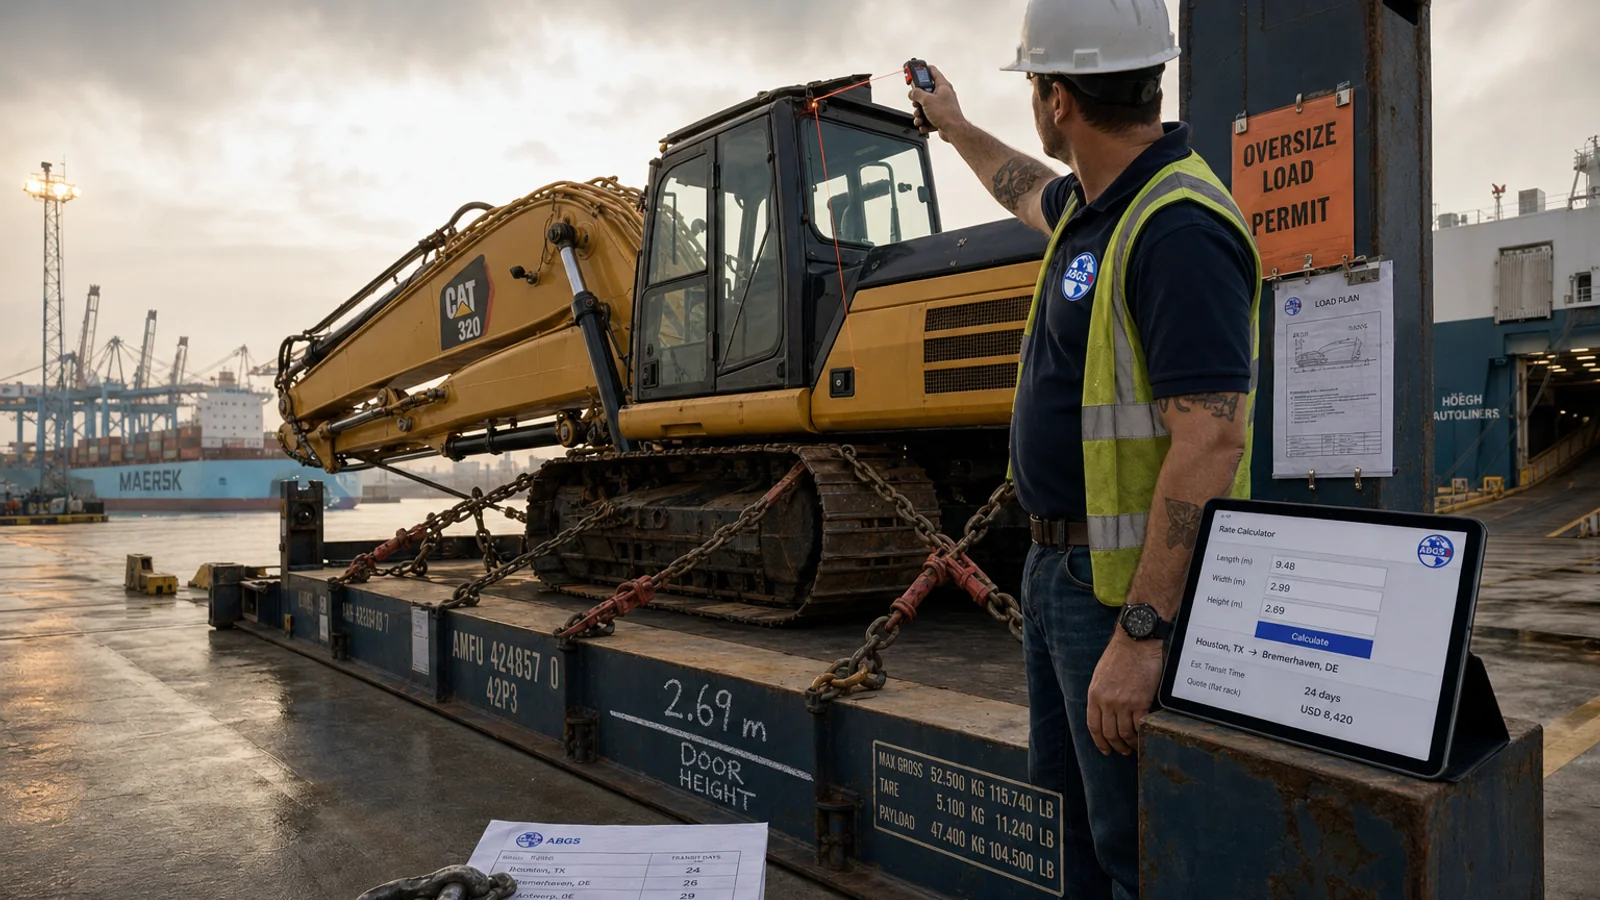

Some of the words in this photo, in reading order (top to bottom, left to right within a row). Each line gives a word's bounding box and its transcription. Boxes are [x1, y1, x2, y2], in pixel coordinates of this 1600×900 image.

[1243, 121, 1337, 168] OVERSIZE
[1263, 159, 1314, 193] LOAD
[1252, 196, 1330, 236] PERMIT
[445, 279, 476, 320] CAT
[1314, 298, 1337, 308] LOAD
[1338, 293, 1360, 304] PLAN
[458, 316, 481, 342] 320
[1433, 408, 1500, 421] AUTOLINERS
[119, 468, 182, 492] MAERSK
[1218, 525, 1236, 534] Rate
[1237, 527, 1276, 538] Calculator
[1216, 554, 1240, 565] Length
[1240, 556, 1253, 566] (m)
[1275, 560, 1296, 571] 9.48
[1212, 574, 1233, 583] Width
[1233, 577, 1246, 587] (m)
[1270, 582, 1291, 593] 2.99
[1206, 596, 1230, 607] Height
[1230, 599, 1243, 609] (m)
[1264, 604, 1285, 615] 2.69
[1291, 632, 1330, 647] Calculate
[452, 630, 484, 666] AMFU
[490, 640, 541, 683] 424857
[1195, 637, 1231, 653] Houston,
[1233, 644, 1244, 654] TX
[1262, 650, 1322, 671] Bremerhaven,
[1325, 662, 1339, 673] DE
[1190, 659, 1202, 670] Est.
[1204, 662, 1227, 675] Transit
[1228, 668, 1246, 679] Time
[486, 675, 518, 714] 42P3
[1186, 677, 1208, 688] Quote
[1208, 681, 1222, 692] (flat
[1223, 685, 1241, 698] rack)
[1304, 686, 1317, 697] 24
[1318, 689, 1341, 703] days
[663, 678, 733, 732] 2.69
[742, 717, 767, 743] m
[1300, 704, 1321, 717] USD
[1323, 710, 1353, 725] 8,420
[680, 741, 745, 785] DOOR
[679, 768, 756, 811] HEIGHT
[878, 751, 896, 769] MAX
[897, 756, 924, 779] GROSS
[930, 766, 965, 792] 52.500
[971, 778, 985, 798] KG
[989, 784, 1033, 813] 115.740
[1039, 799, 1054, 820] LB
[879, 777, 900, 798] TARE
[936, 793, 965, 819] 5.100
[971, 805, 985, 825] KG
[995, 813, 1033, 842] 11.240
[1039, 827, 1055, 849] LB
[545, 837, 581, 845] ABGS
[879, 804, 915, 830] PAYLOAD
[930, 820, 966, 848] 47.400
[971, 834, 985, 855] KG
[989, 841, 1034, 873] 104.500
[1039, 858, 1055, 880] LB
[682, 879, 698, 887] 26
